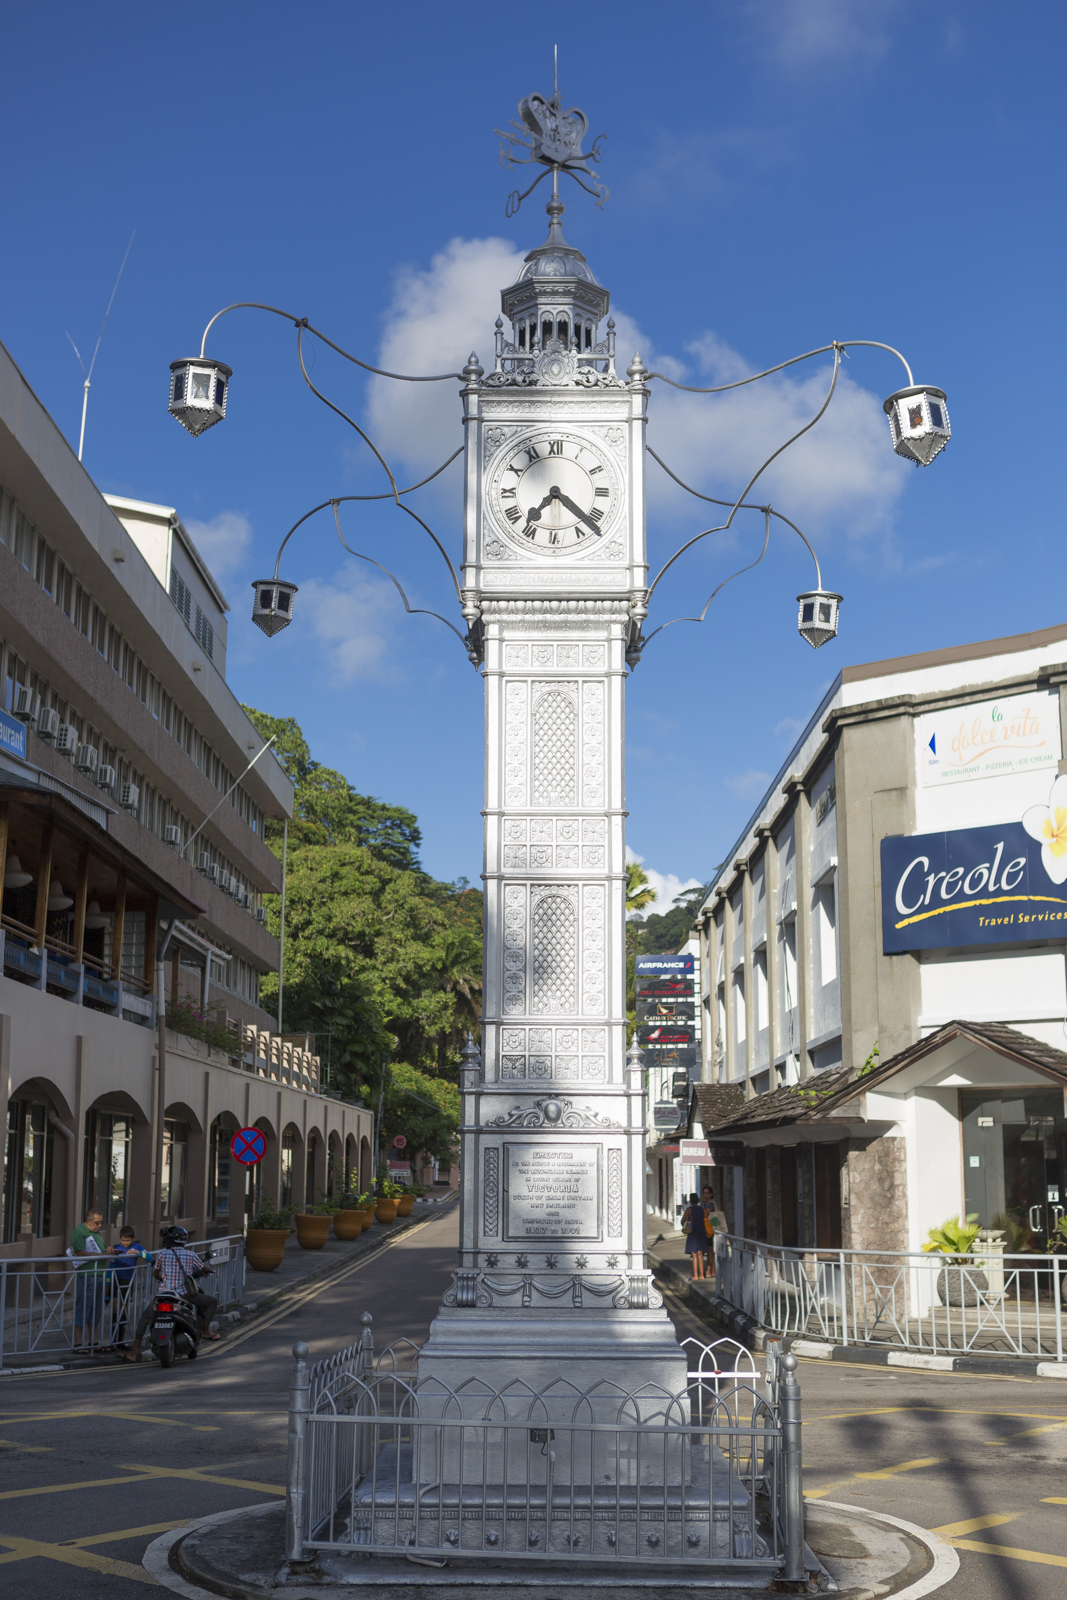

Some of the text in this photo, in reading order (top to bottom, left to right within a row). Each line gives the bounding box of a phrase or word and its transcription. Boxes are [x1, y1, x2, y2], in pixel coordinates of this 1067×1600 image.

[991, 706, 1004, 722] la
[951, 707, 1042, 761] dolce vita
[941, 766, 981, 778] RESTAURANT
[985, 761, 1013, 771] PIZZERIA
[1030, 754, 1053, 764] CREAM
[895, 841, 1027, 915] Creole
[979, 910, 1067, 927] Travel Services
[396, 1138, 404, 1146] 15
[533, 1151, 573, 1159] ERECTED
[682, 1147, 706, 1156] BUREAU
[527, 1184, 579, 1193] VICTORIA
